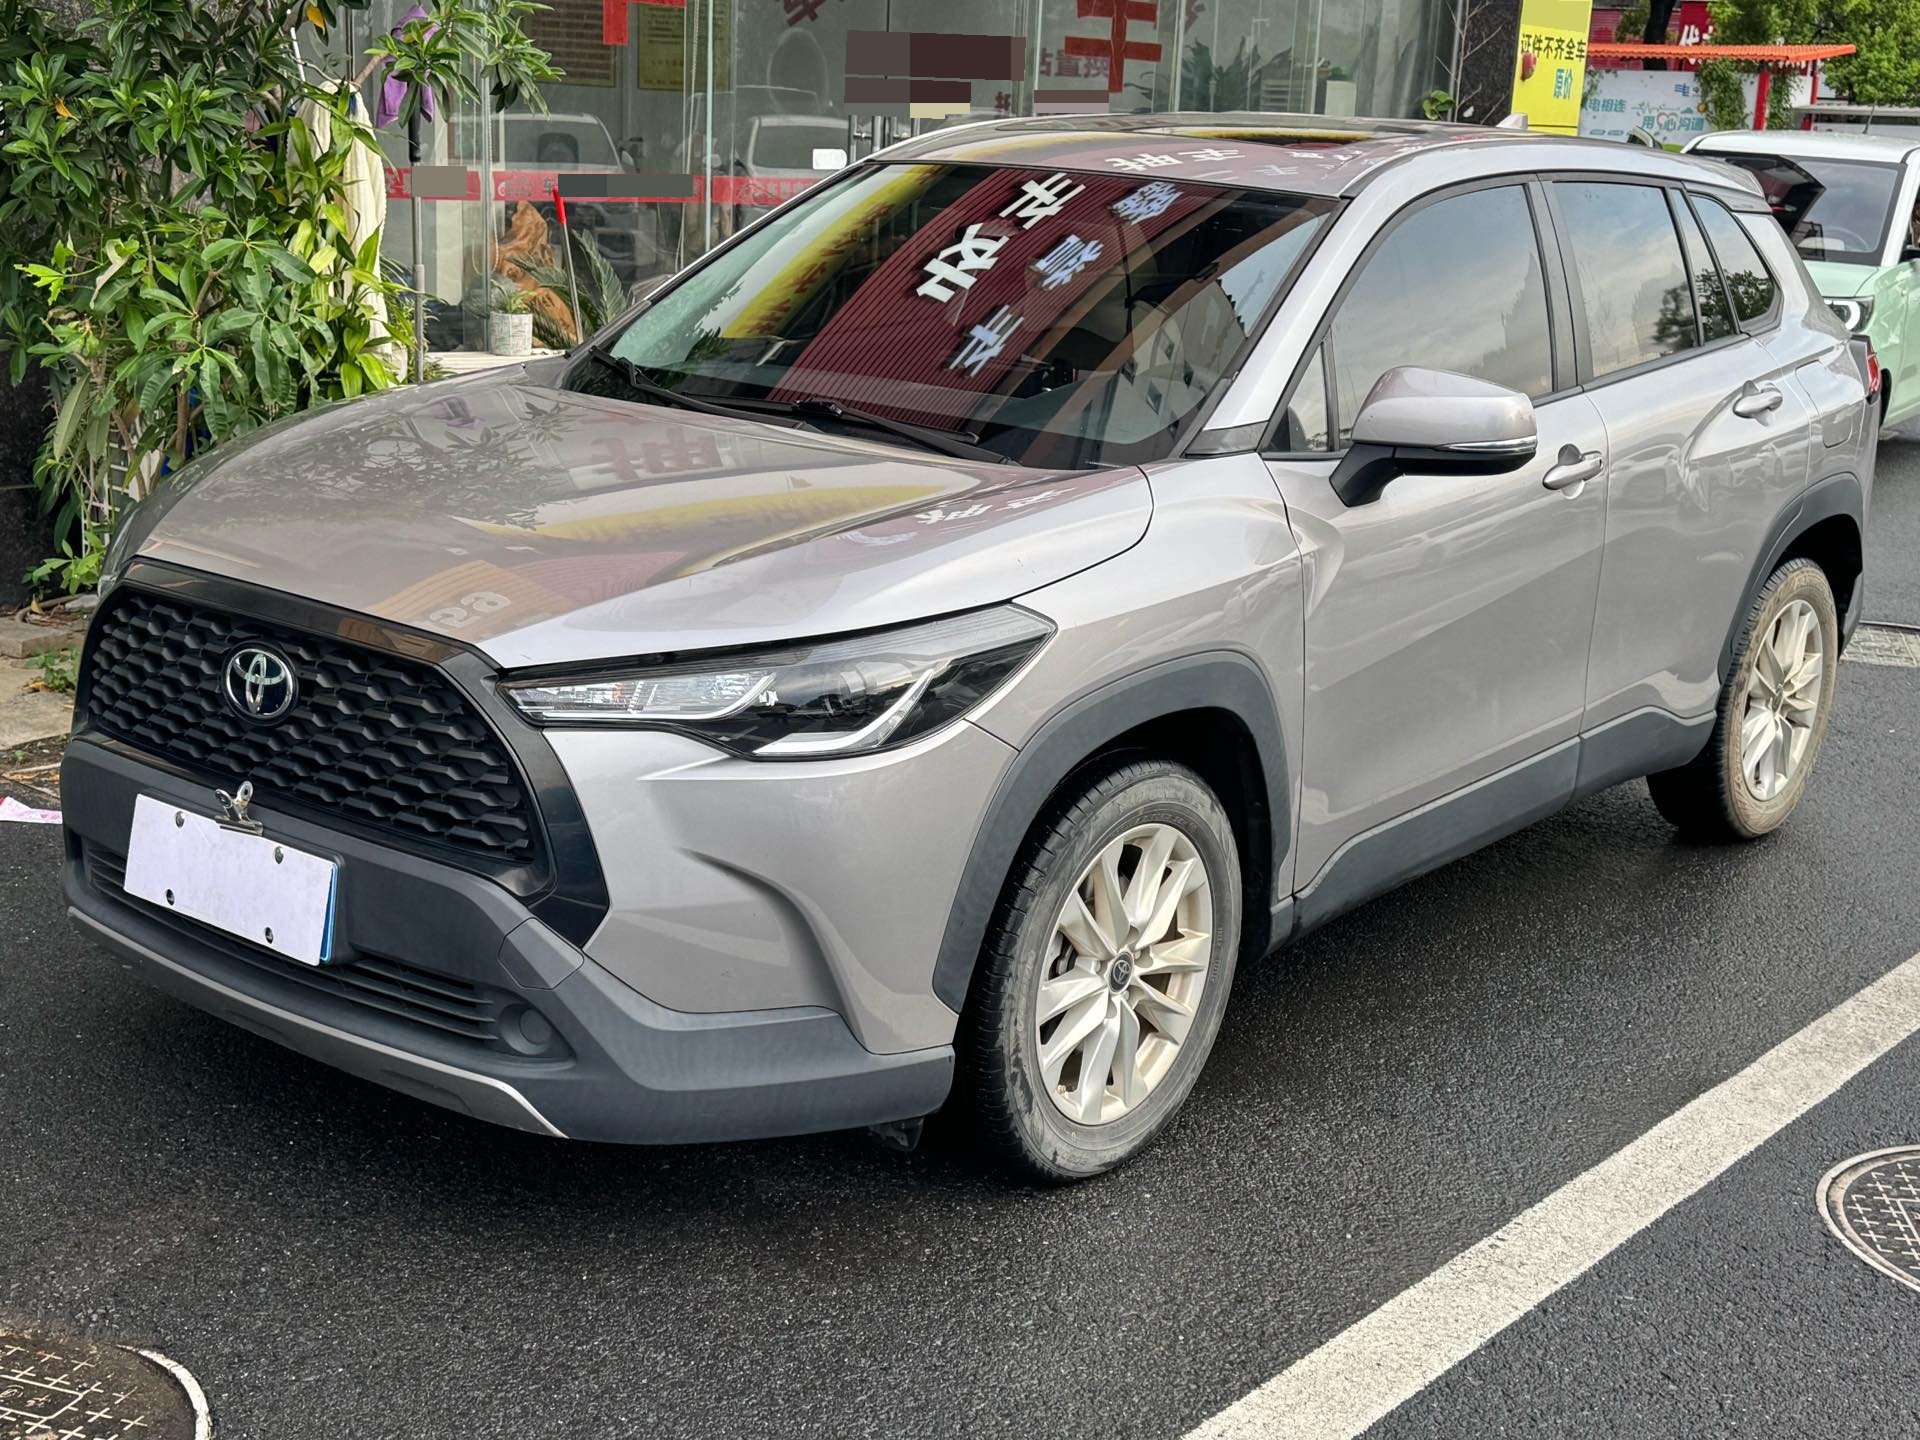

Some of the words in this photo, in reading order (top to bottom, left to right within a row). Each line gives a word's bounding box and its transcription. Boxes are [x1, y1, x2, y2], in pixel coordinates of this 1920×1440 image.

[1520, 33, 1586, 62] 证件不齐全车
